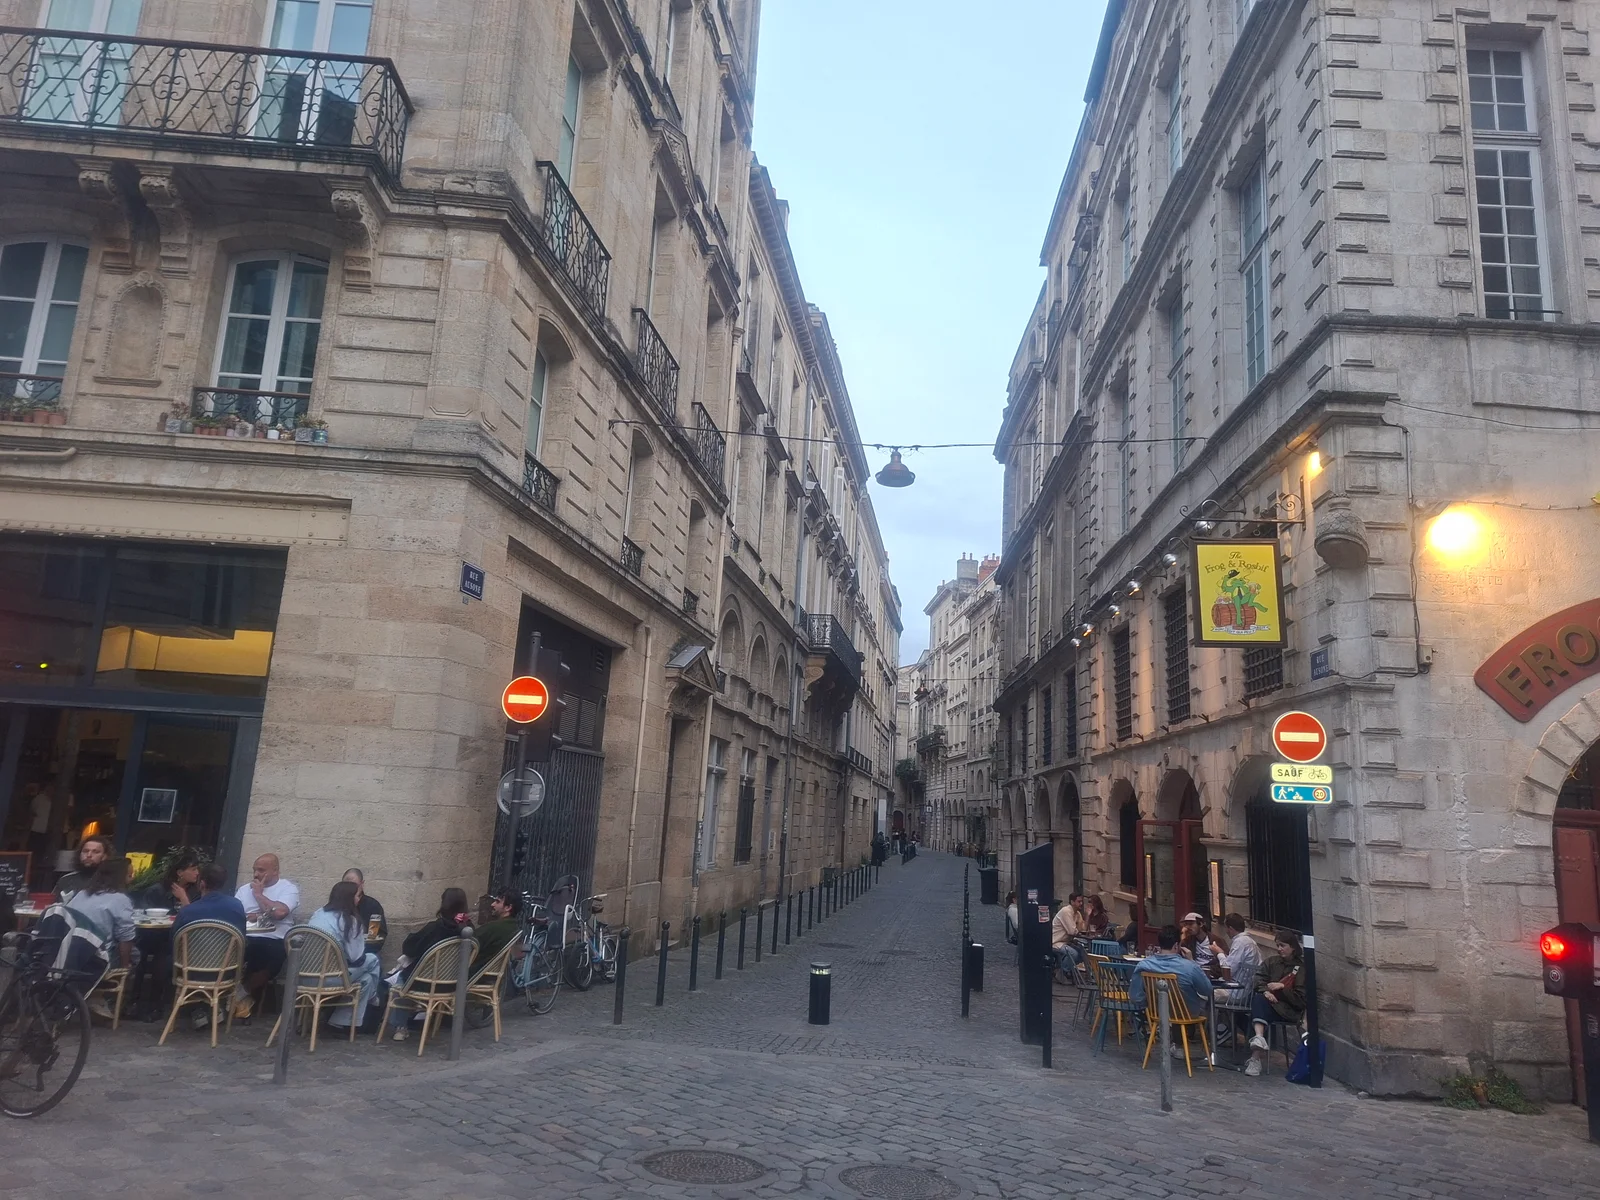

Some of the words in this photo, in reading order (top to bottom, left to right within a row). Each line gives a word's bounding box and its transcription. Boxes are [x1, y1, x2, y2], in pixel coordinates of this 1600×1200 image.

[1229, 551, 1242, 560] The
[1204, 563, 1226, 573] Frog
[1228, 560, 1236, 568] &
[1238, 560, 1269, 573] Rosbif
[470, 571, 479, 581] RUE
[1495, 618, 1600, 708] FRO
[1277, 768, 1304, 778] SAUF
